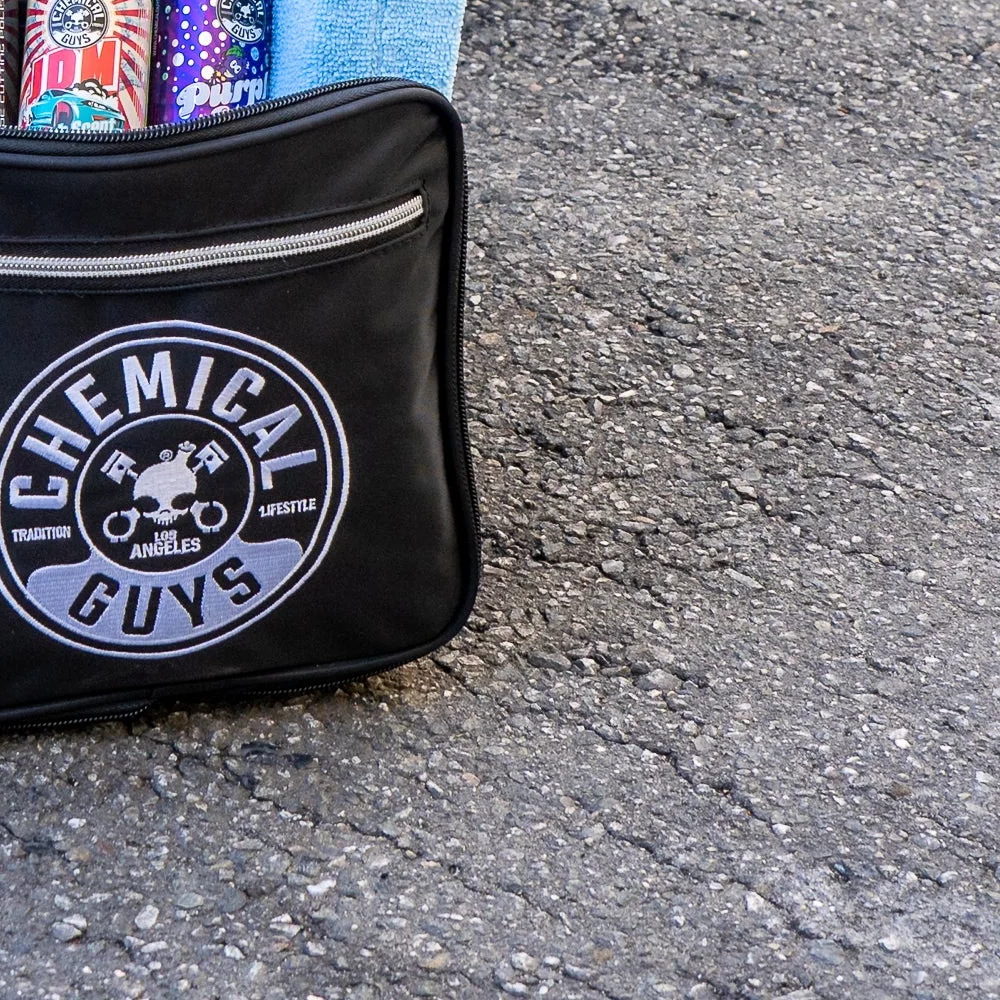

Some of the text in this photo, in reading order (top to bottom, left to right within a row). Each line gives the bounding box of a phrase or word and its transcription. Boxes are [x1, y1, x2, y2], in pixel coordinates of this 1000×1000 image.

[61, 33, 92, 46] GUYS
[231, 25, 257, 40] GUYS
[30, 38, 121, 101] JDM
[9, 350, 318, 510] CHEMICAL
[258, 498, 317, 518] LIFESTYLE
[11, 525, 72, 543] TRADITION
[154, 530, 178, 543] LOS
[129, 537, 202, 560] ANGELES
[67, 556, 262, 636] GUYS
